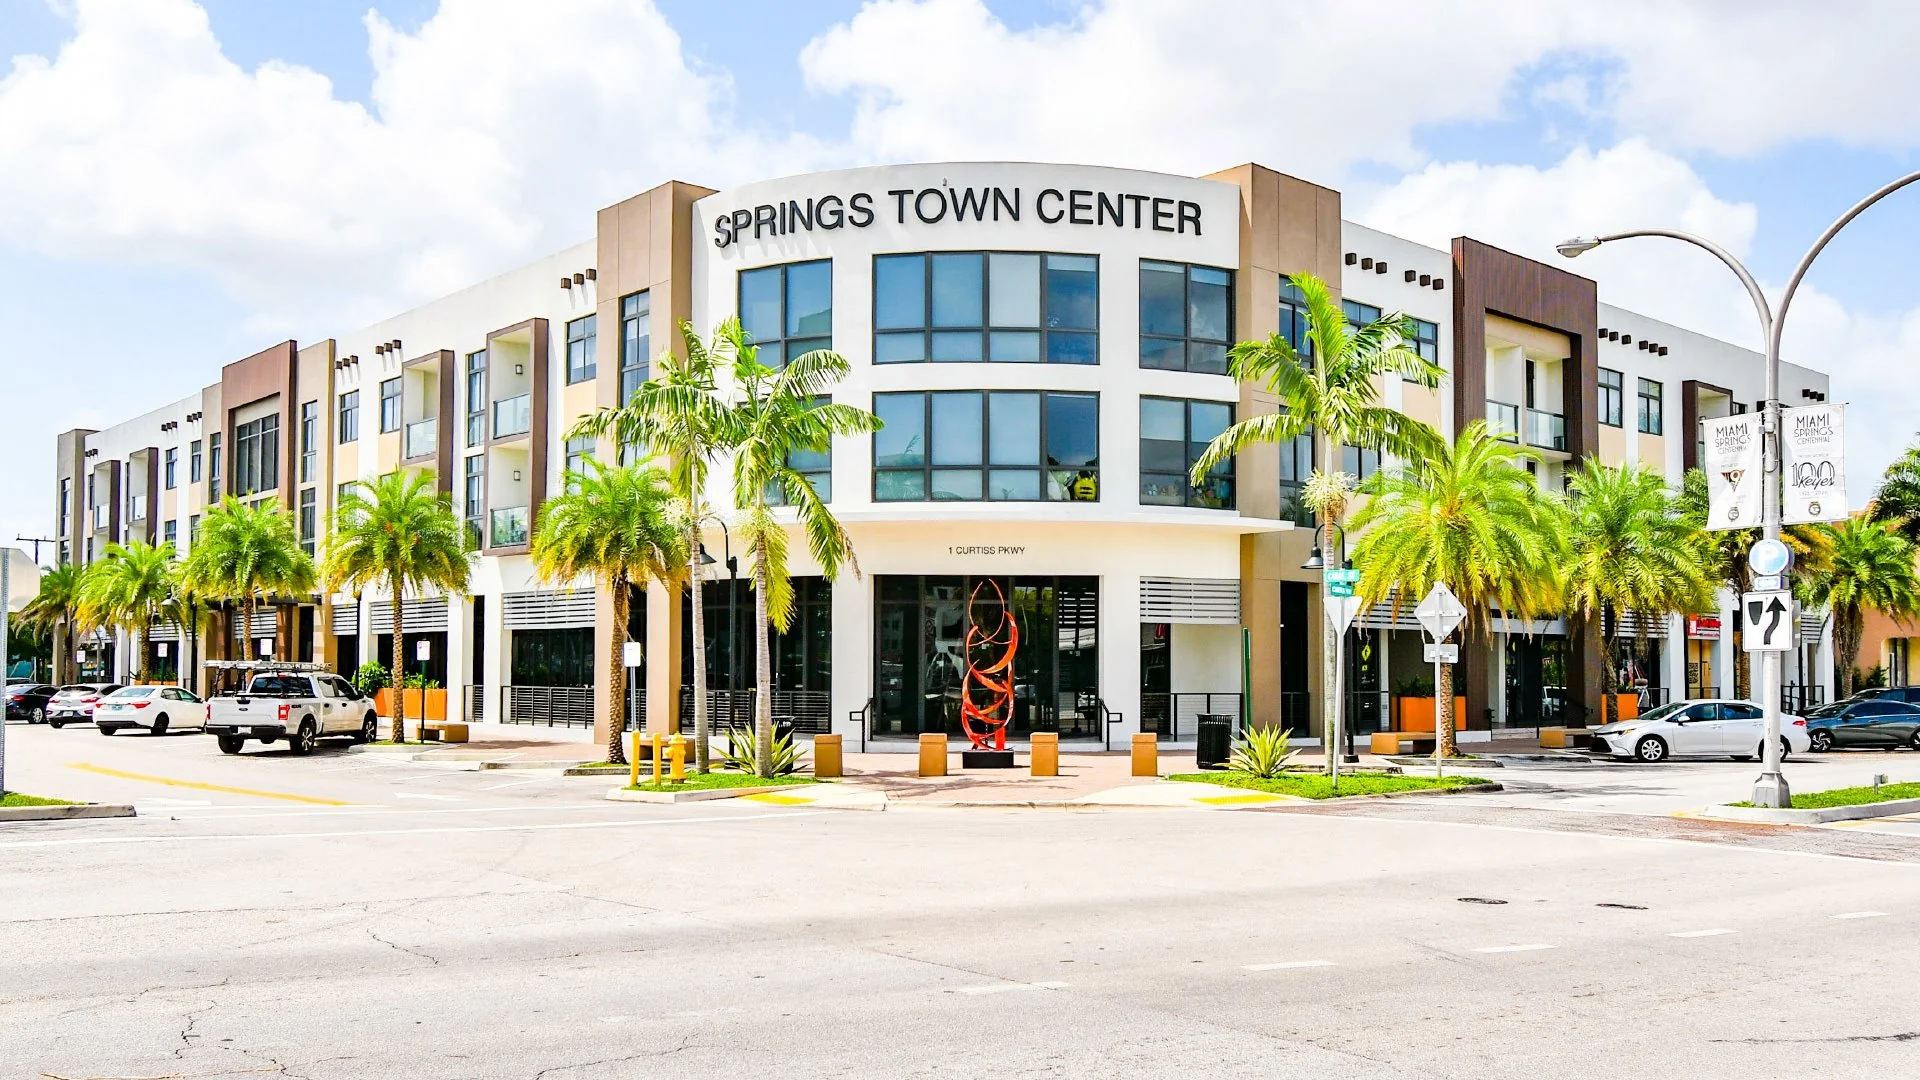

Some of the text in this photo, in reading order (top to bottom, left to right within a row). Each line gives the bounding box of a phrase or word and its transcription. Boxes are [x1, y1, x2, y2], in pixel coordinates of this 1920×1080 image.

[714, 187, 1203, 248] SPRINGS TOWN CENTER
[1796, 413, 1829, 428] MIAMI
[1716, 423, 1748, 438] MIAMI
[1793, 427, 1834, 438] SPRINGS
[1715, 434, 1751, 448] SPRINGS
[1796, 436, 1830, 445] CENTENNIAL
[948, 546, 1024, 555] 1 CURTISS PKWY
